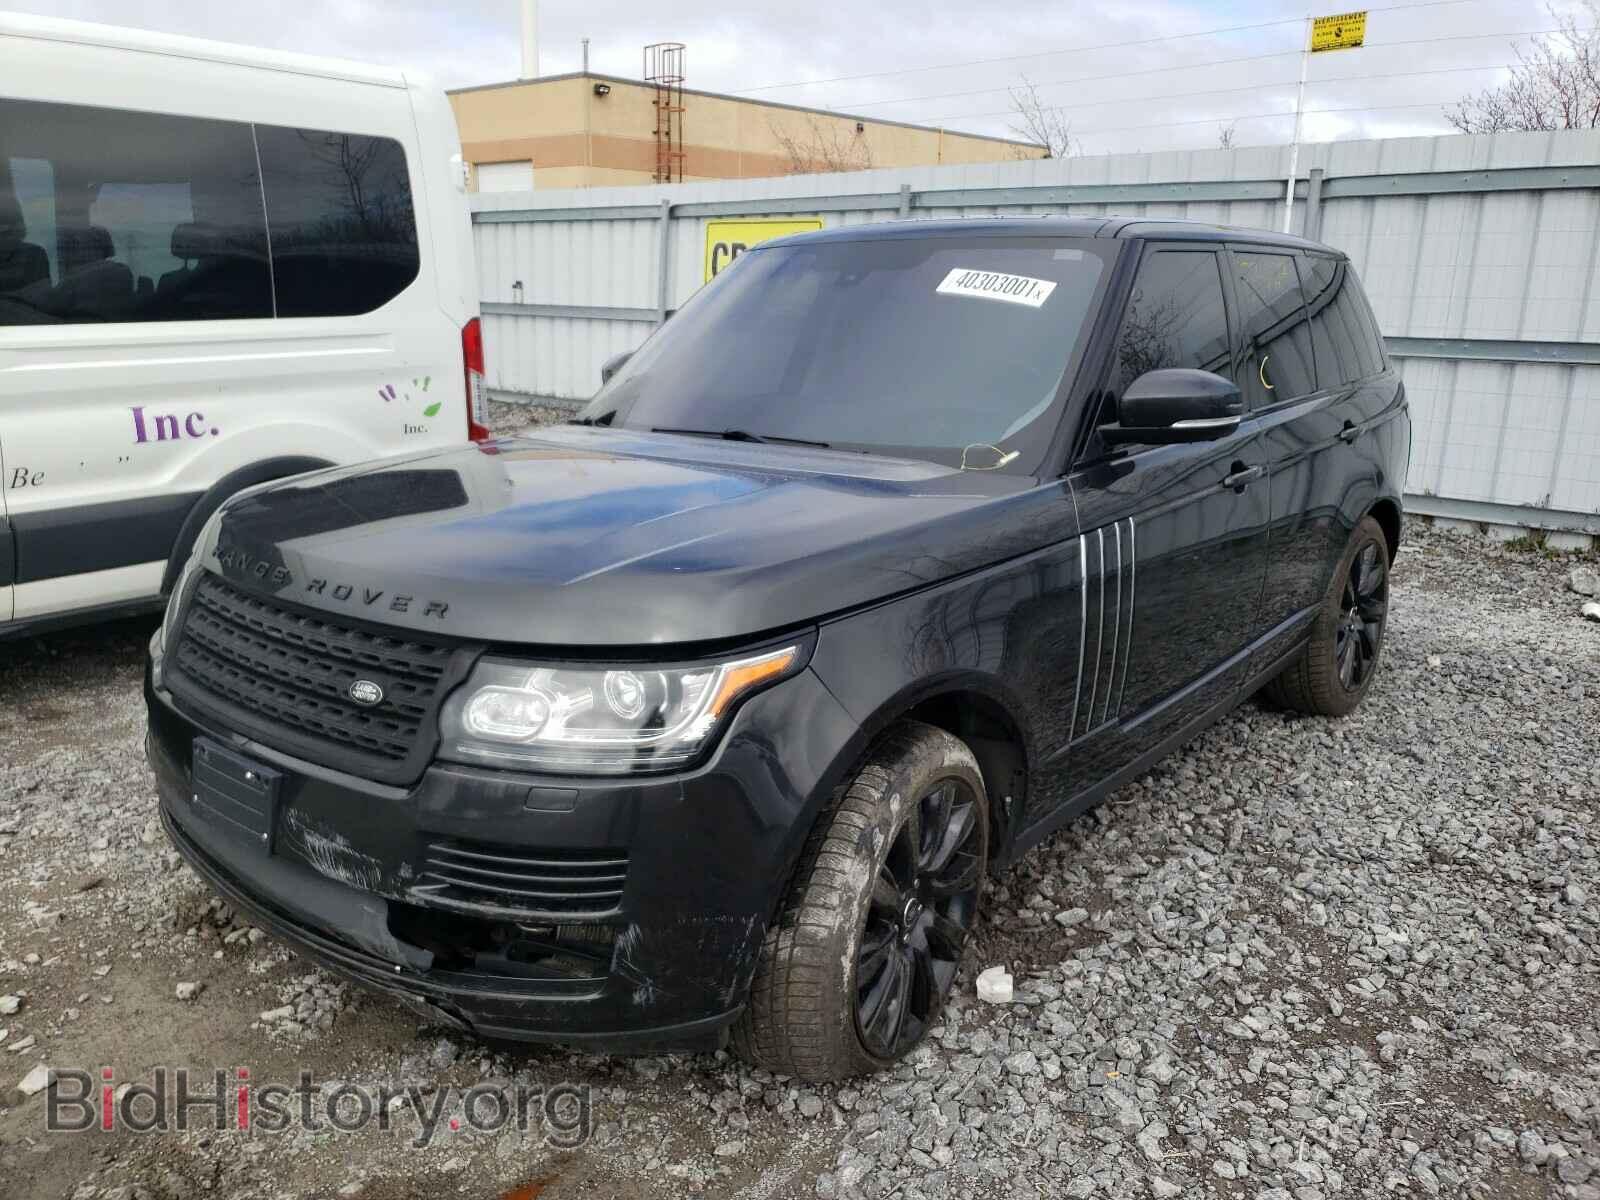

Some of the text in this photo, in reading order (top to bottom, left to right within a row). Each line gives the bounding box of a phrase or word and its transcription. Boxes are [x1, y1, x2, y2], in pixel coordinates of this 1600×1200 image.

[129, 406, 219, 443] Inc.
[404, 423, 429, 434] Inc.
[10, 466, 46, 489] Be
[305, 578, 450, 620] ROVER
